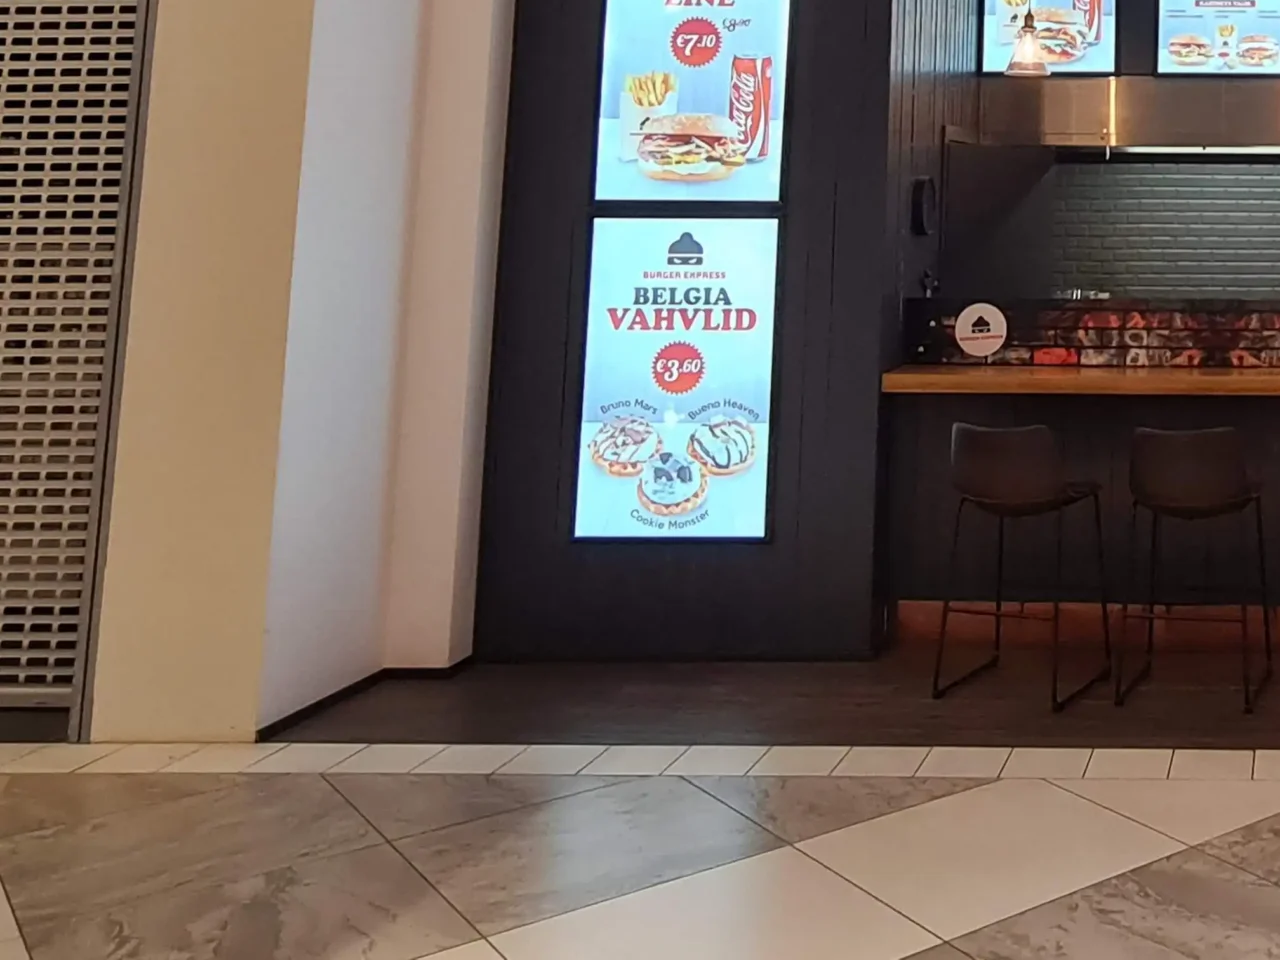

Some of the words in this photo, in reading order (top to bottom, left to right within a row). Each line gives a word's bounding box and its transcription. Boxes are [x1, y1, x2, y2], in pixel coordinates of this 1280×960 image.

[676, 34, 717, 56] €7.10
[643, 271, 681, 279] BURGER
[684, 271, 726, 279] EXPRESS
[633, 287, 732, 305] BELGIA
[606, 308, 757, 331] VAHVLID
[656, 358, 701, 381] €3.60
[600, 399, 631, 415] Bruno
[634, 398, 658, 415] Mars
[688, 400, 721, 420] Bueno
[723, 398, 760, 420] Heaven
[630, 509, 665, 530] Cookie
[668, 509, 710, 530] Monster
